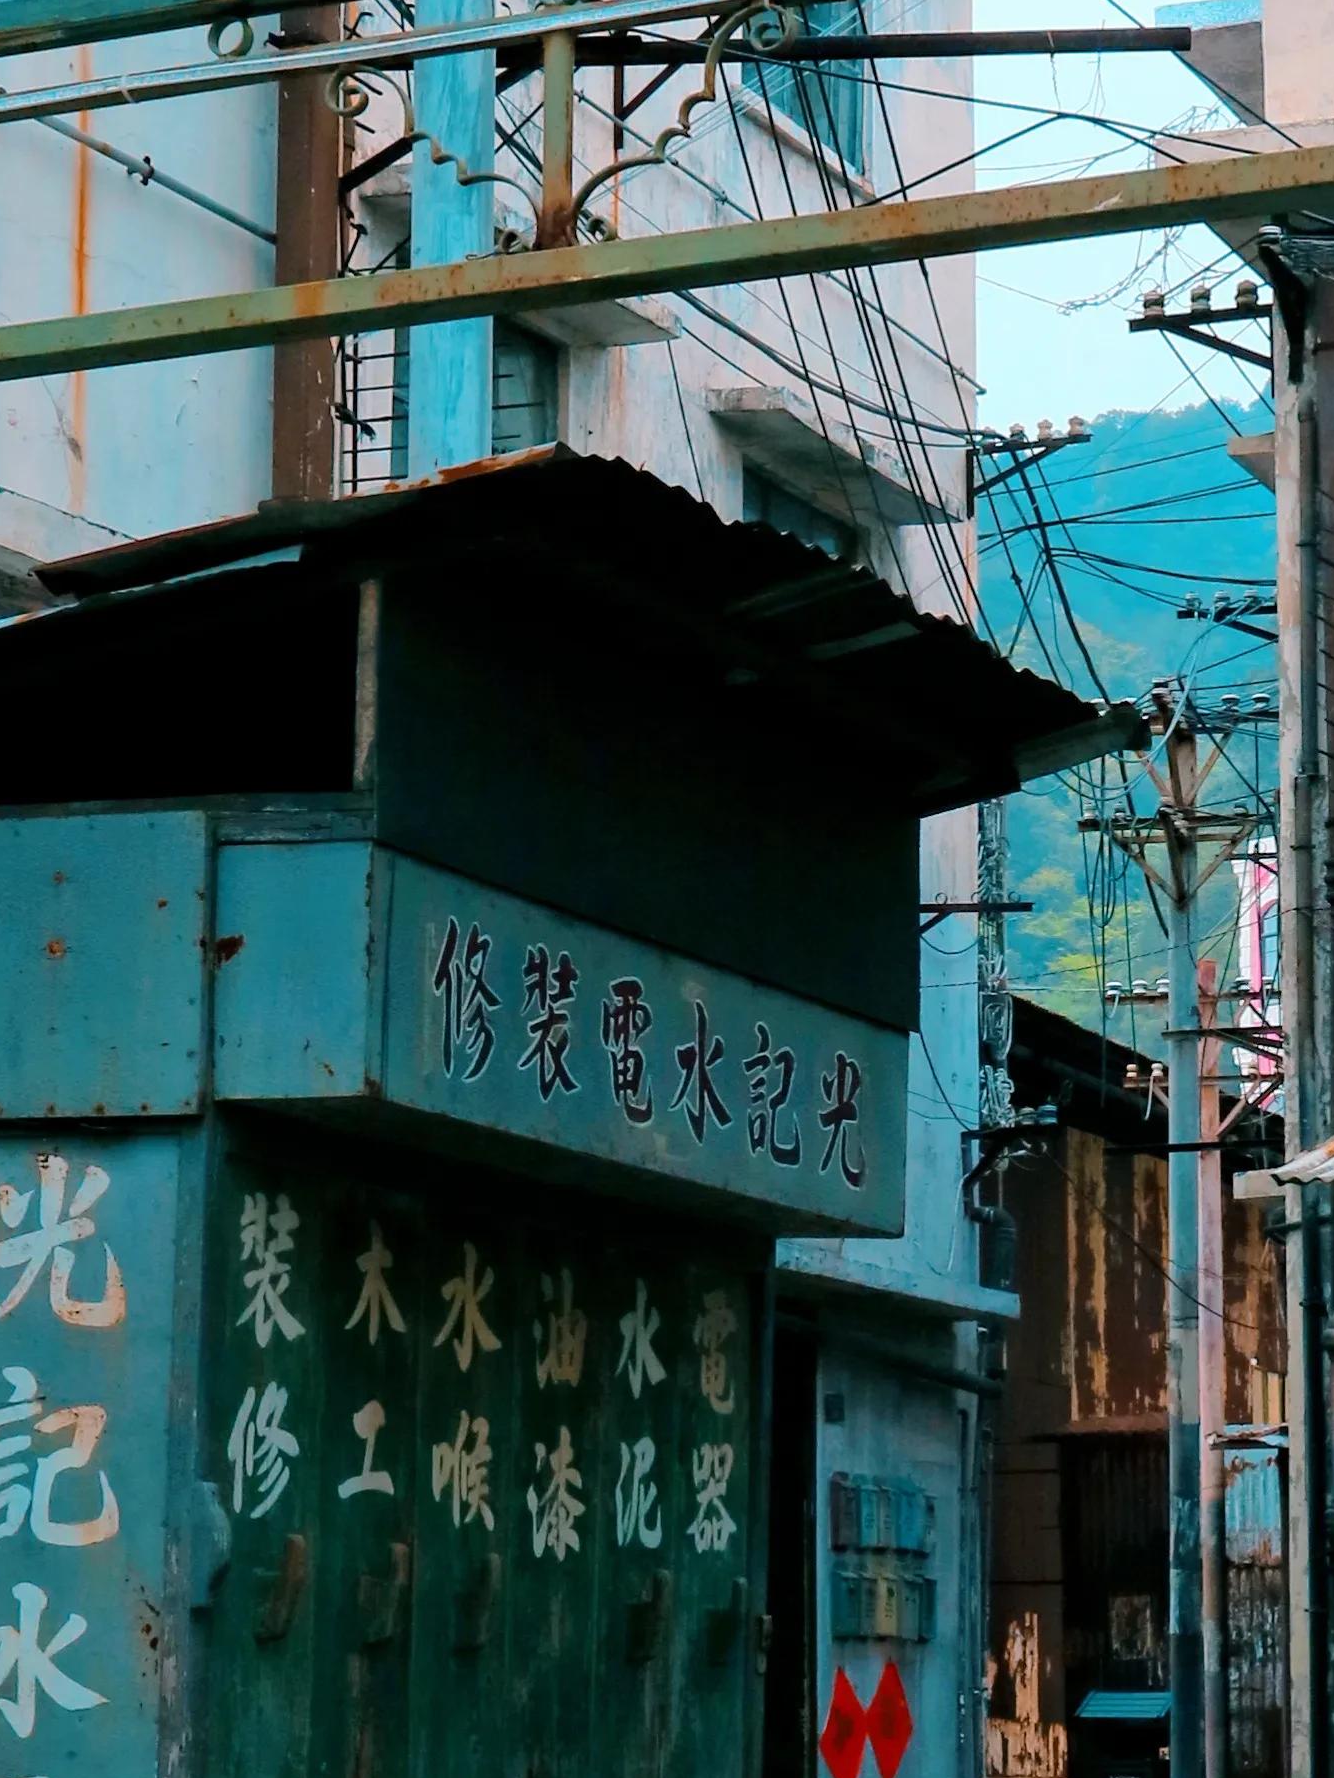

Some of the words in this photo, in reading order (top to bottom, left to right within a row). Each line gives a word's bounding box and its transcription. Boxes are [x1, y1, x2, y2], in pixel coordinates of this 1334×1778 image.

[432, 915, 867, 1190] 光記水電裝修
[227, 1190, 307, 1520] 裝修
[337, 1216, 407, 1500] 木工
[431, 1239, 503, 1533] 水喉
[525, 1265, 588, 1563] 油漆
[614, 1277, 668, 1551] 水泥
[685, 1288, 739, 1556] 電器
